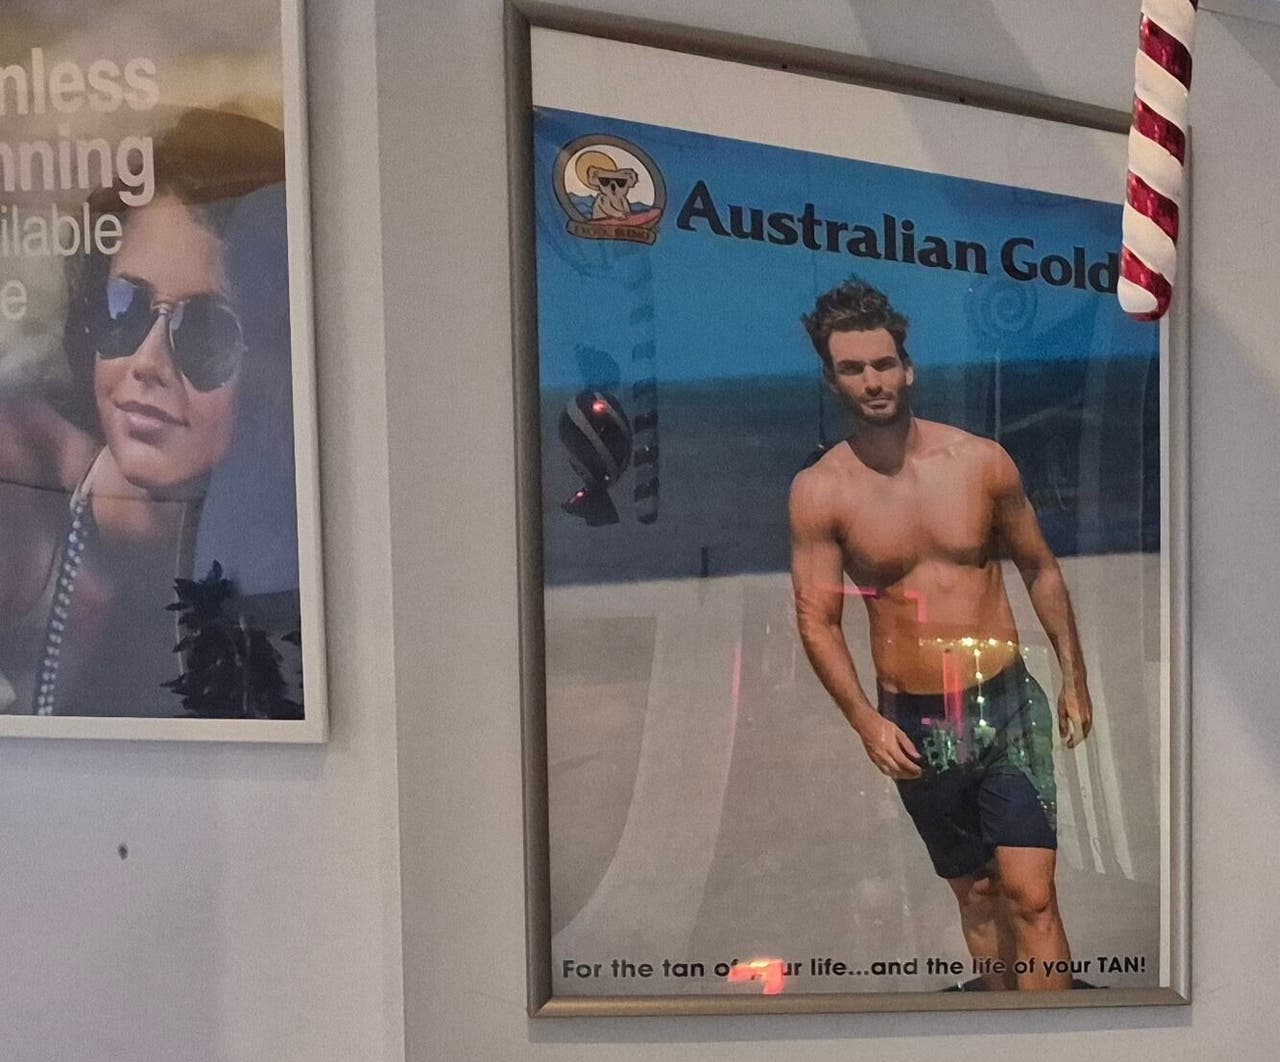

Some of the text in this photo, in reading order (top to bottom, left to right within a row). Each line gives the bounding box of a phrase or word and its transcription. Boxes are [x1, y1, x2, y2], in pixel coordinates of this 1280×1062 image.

[675, 179, 1120, 295] Australian Gold
[562, 959, 602, 978] For
[610, 959, 654, 978] the
[662, 958, 705, 977] tan
[926, 957, 964, 975] the
[971, 957, 1006, 975] life
[1014, 957, 1035, 975] of
[1041, 959, 1091, 977] your
[1097, 956, 1146, 974] TAN!
